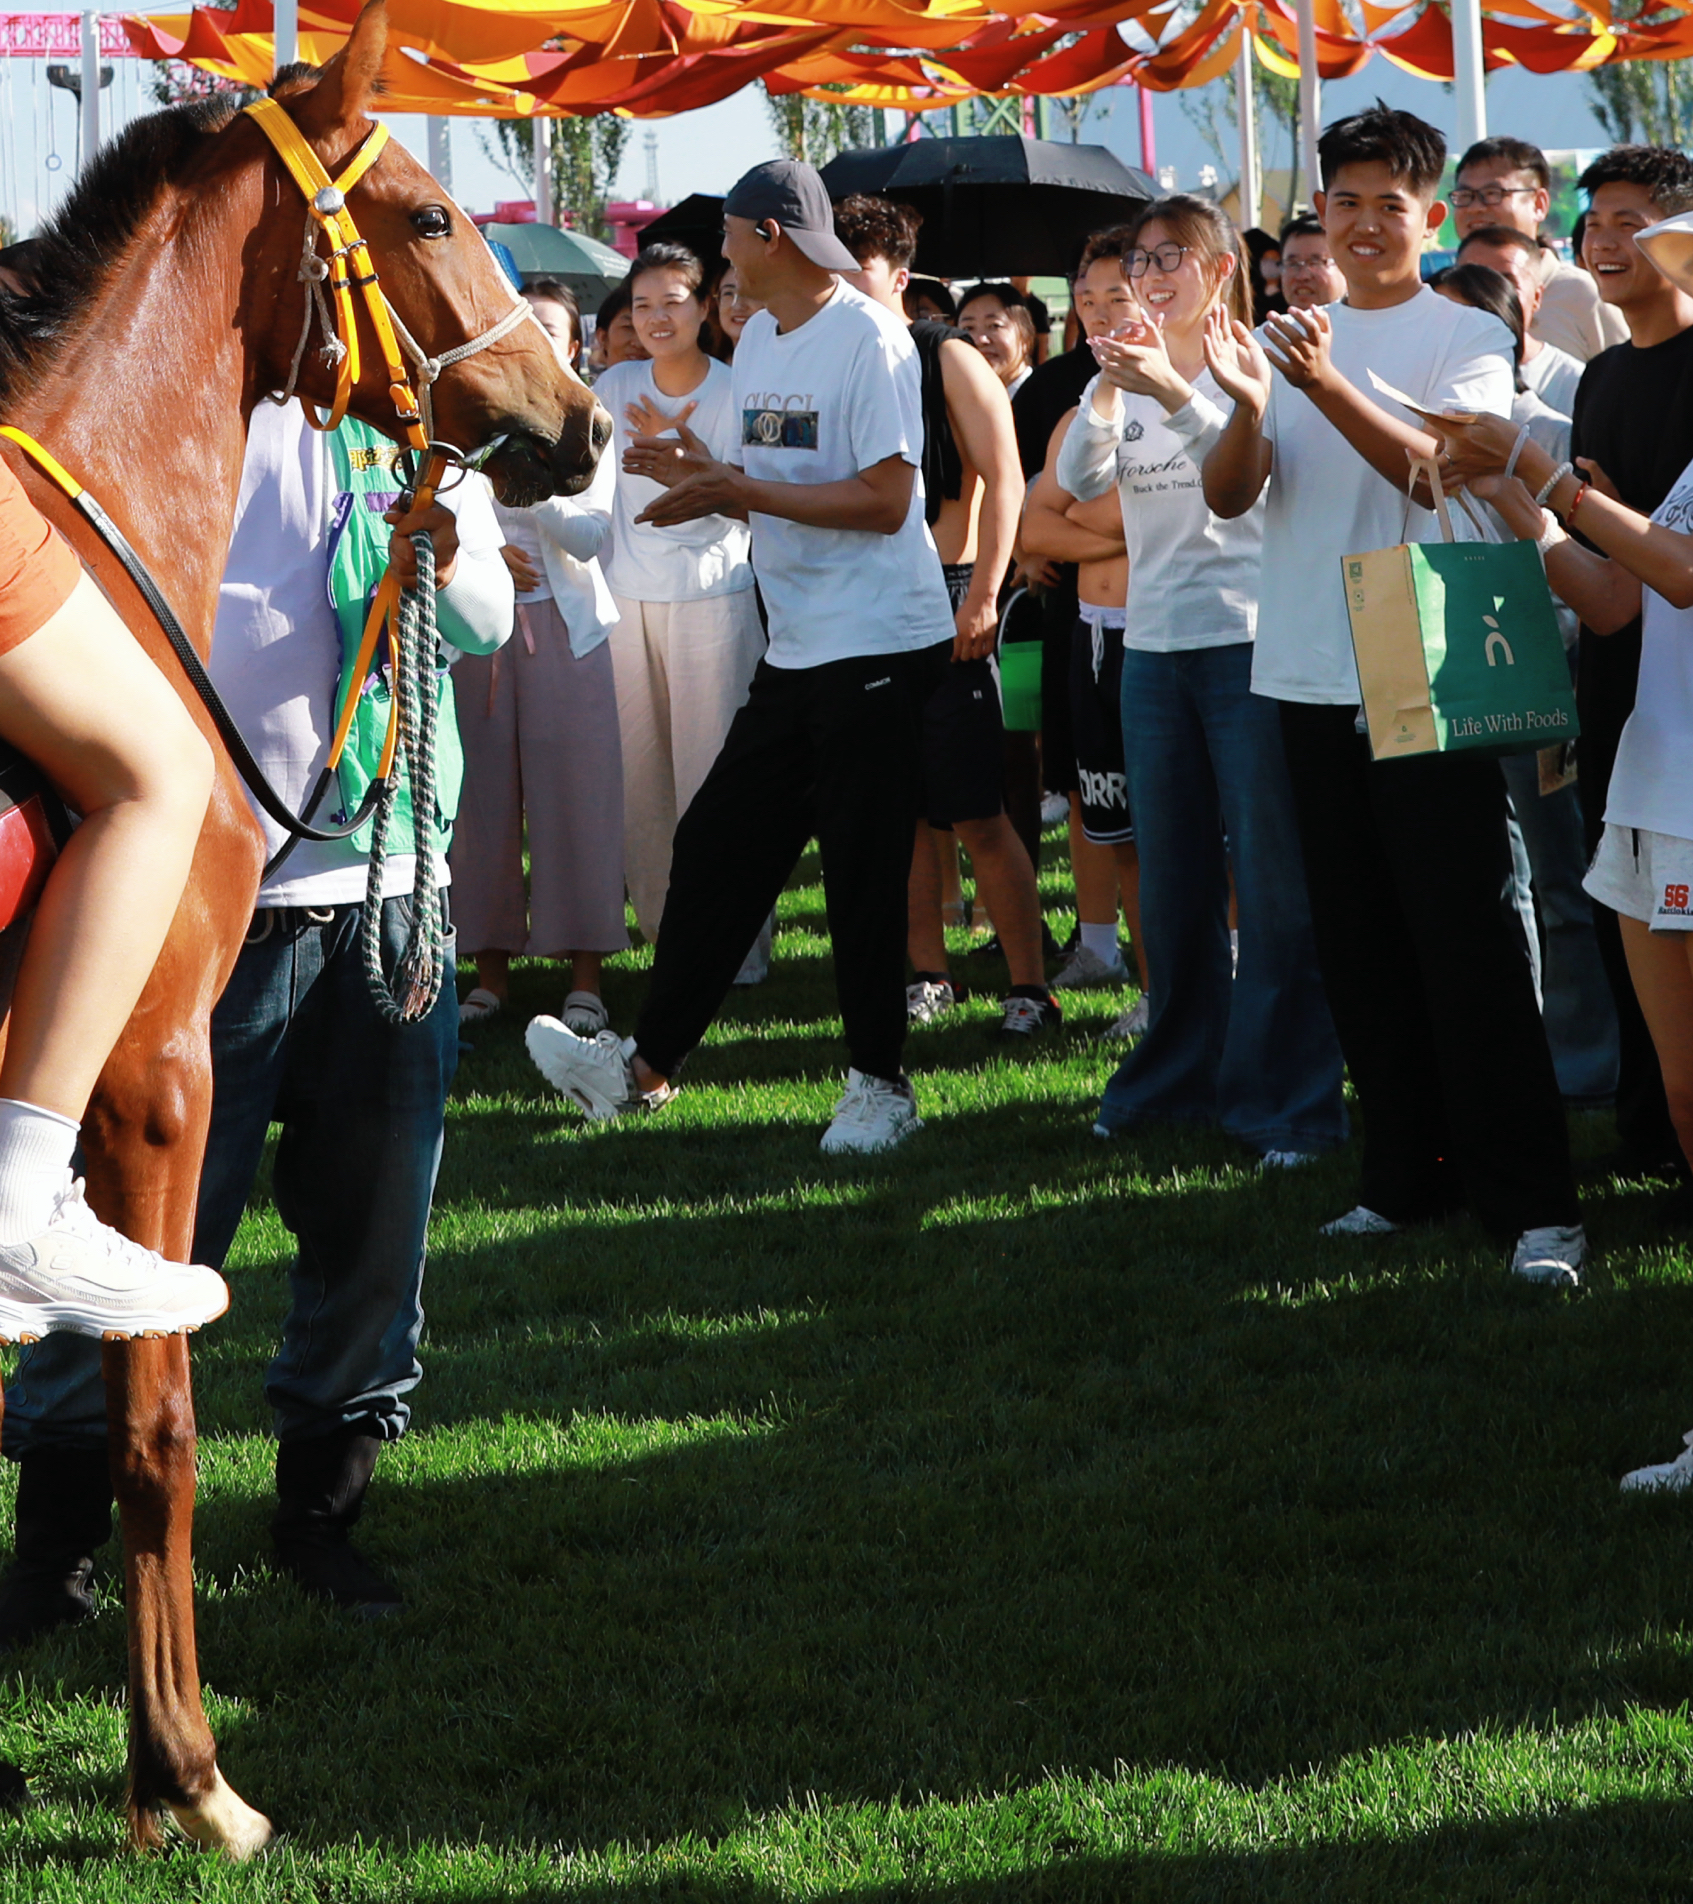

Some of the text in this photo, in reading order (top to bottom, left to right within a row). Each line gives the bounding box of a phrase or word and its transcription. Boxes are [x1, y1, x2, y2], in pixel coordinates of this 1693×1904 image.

[1156, 482, 1169, 492] the
[1451, 708, 1569, 737] Life With Foods
[1664, 883, 1690, 908] 56
